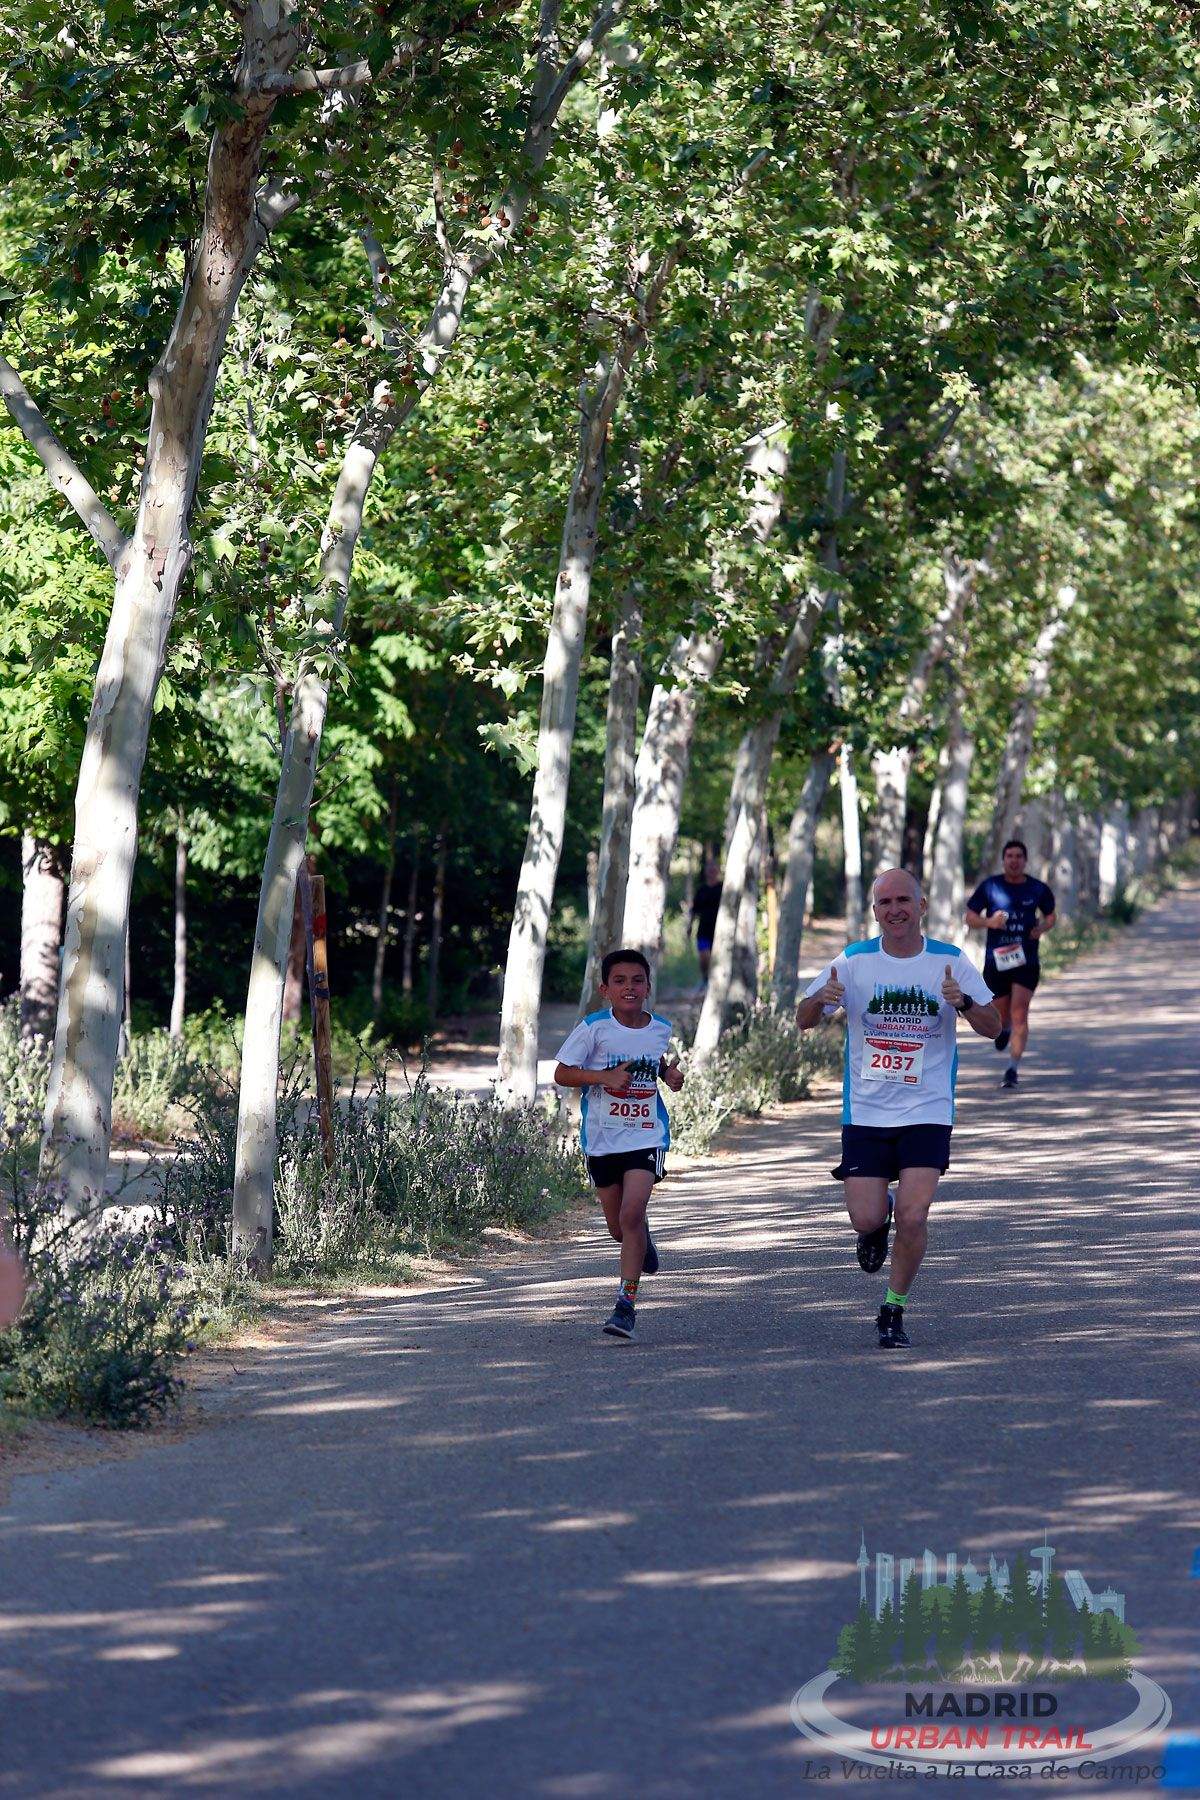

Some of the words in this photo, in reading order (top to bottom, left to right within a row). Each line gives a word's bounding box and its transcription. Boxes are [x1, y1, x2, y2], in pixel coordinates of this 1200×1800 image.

[883, 1016, 922, 1025] MADRID
[876, 1023, 905, 1031] URBAN
[871, 1053, 915, 1071] 2037
[609, 1102, 650, 1118] 2036
